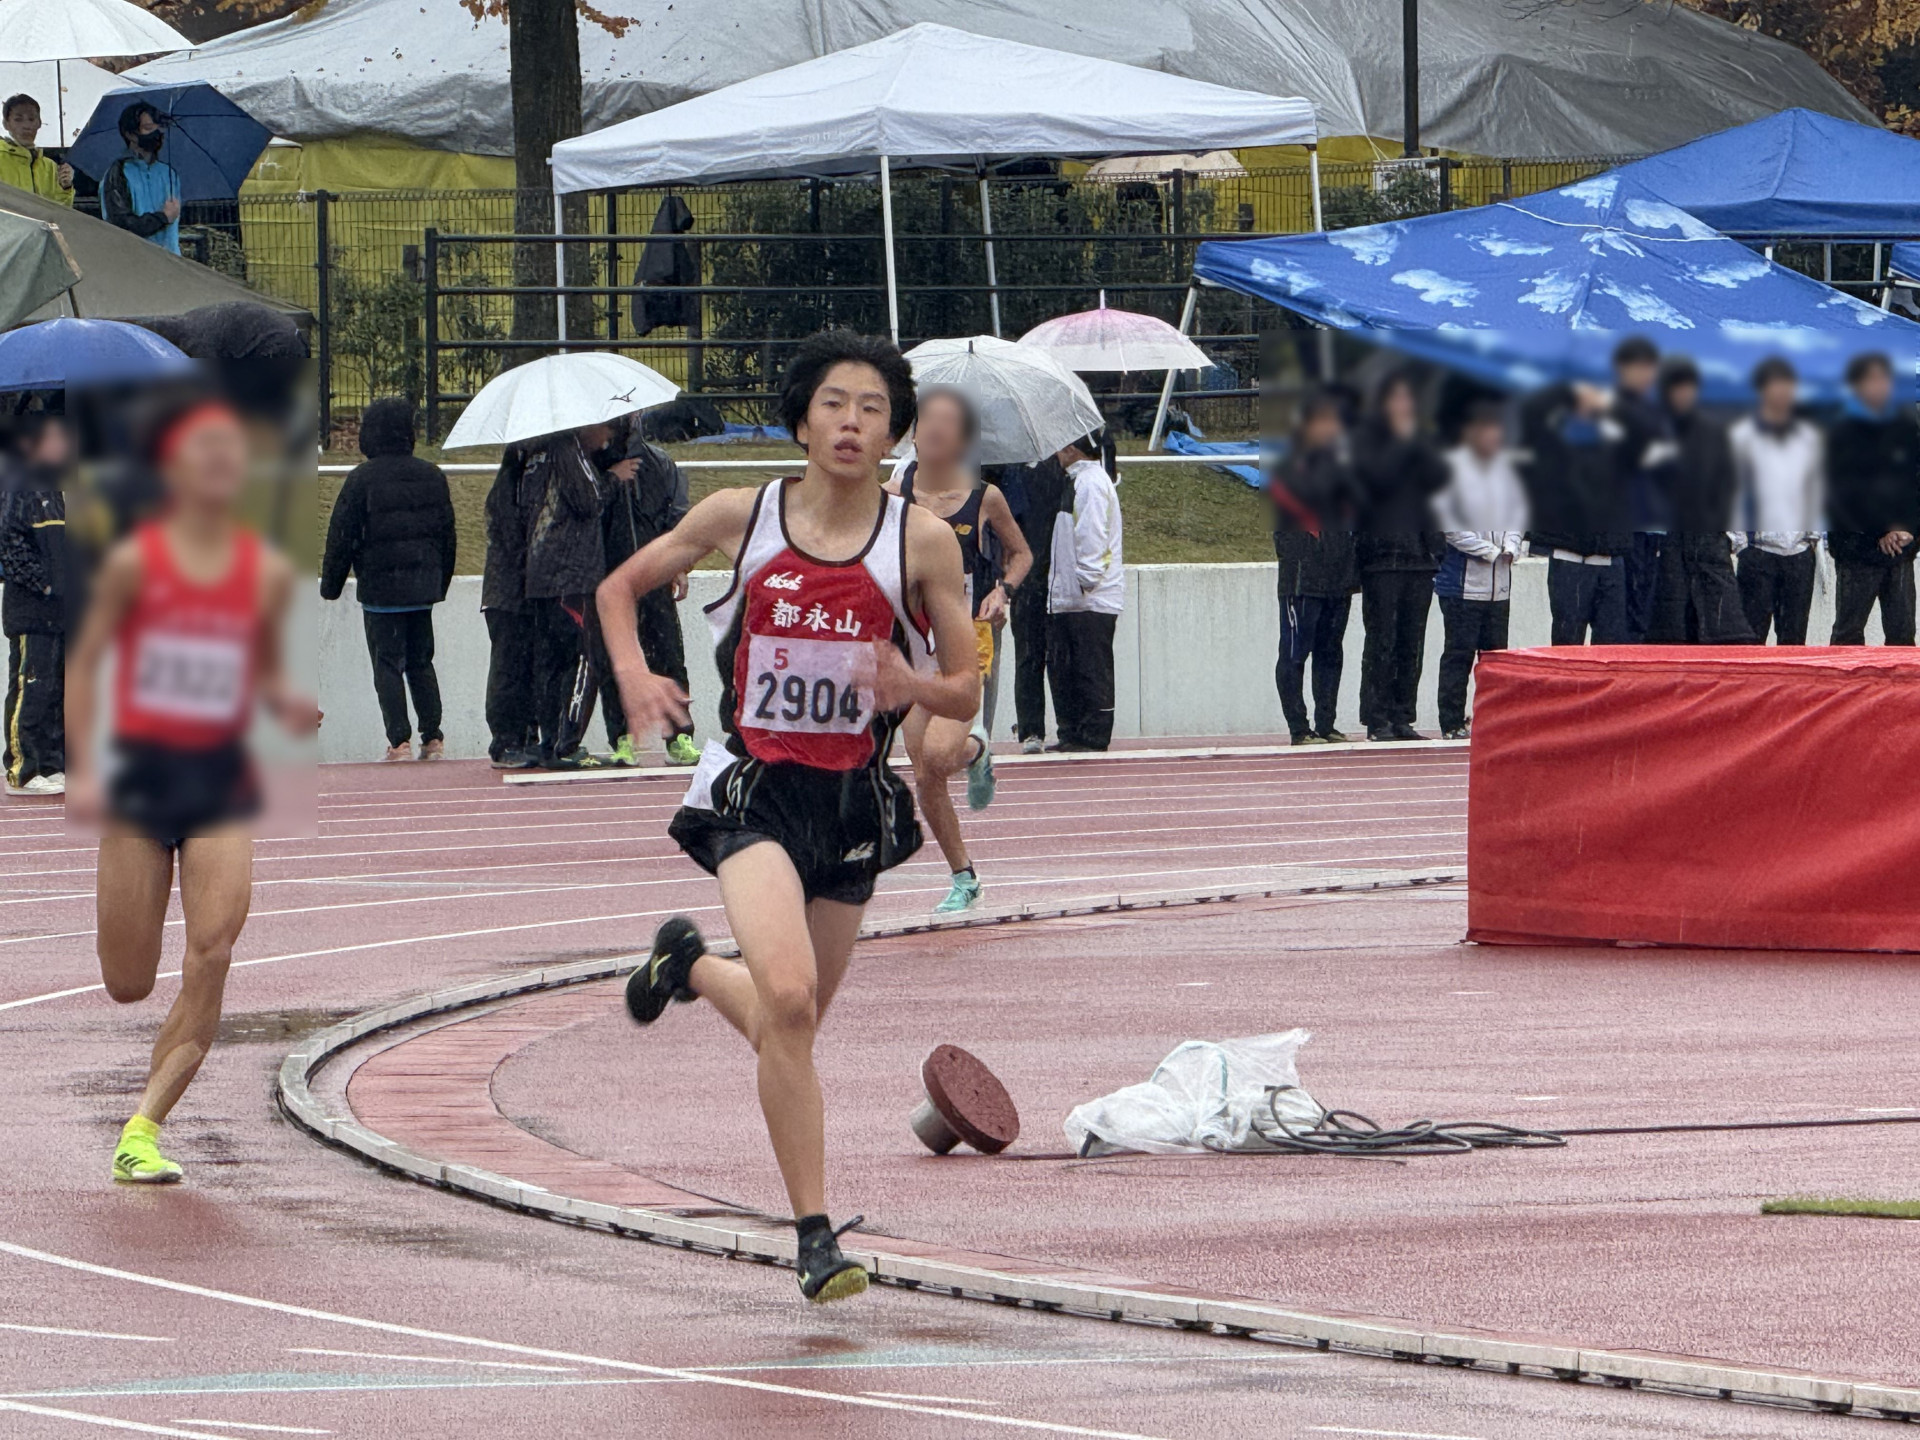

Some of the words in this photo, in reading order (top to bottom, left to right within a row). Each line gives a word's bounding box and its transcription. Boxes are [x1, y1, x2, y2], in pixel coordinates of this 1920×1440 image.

[771, 598, 861, 637] 都永山
[774, 648, 789, 670] 5
[755, 672, 861, 723] 2904
